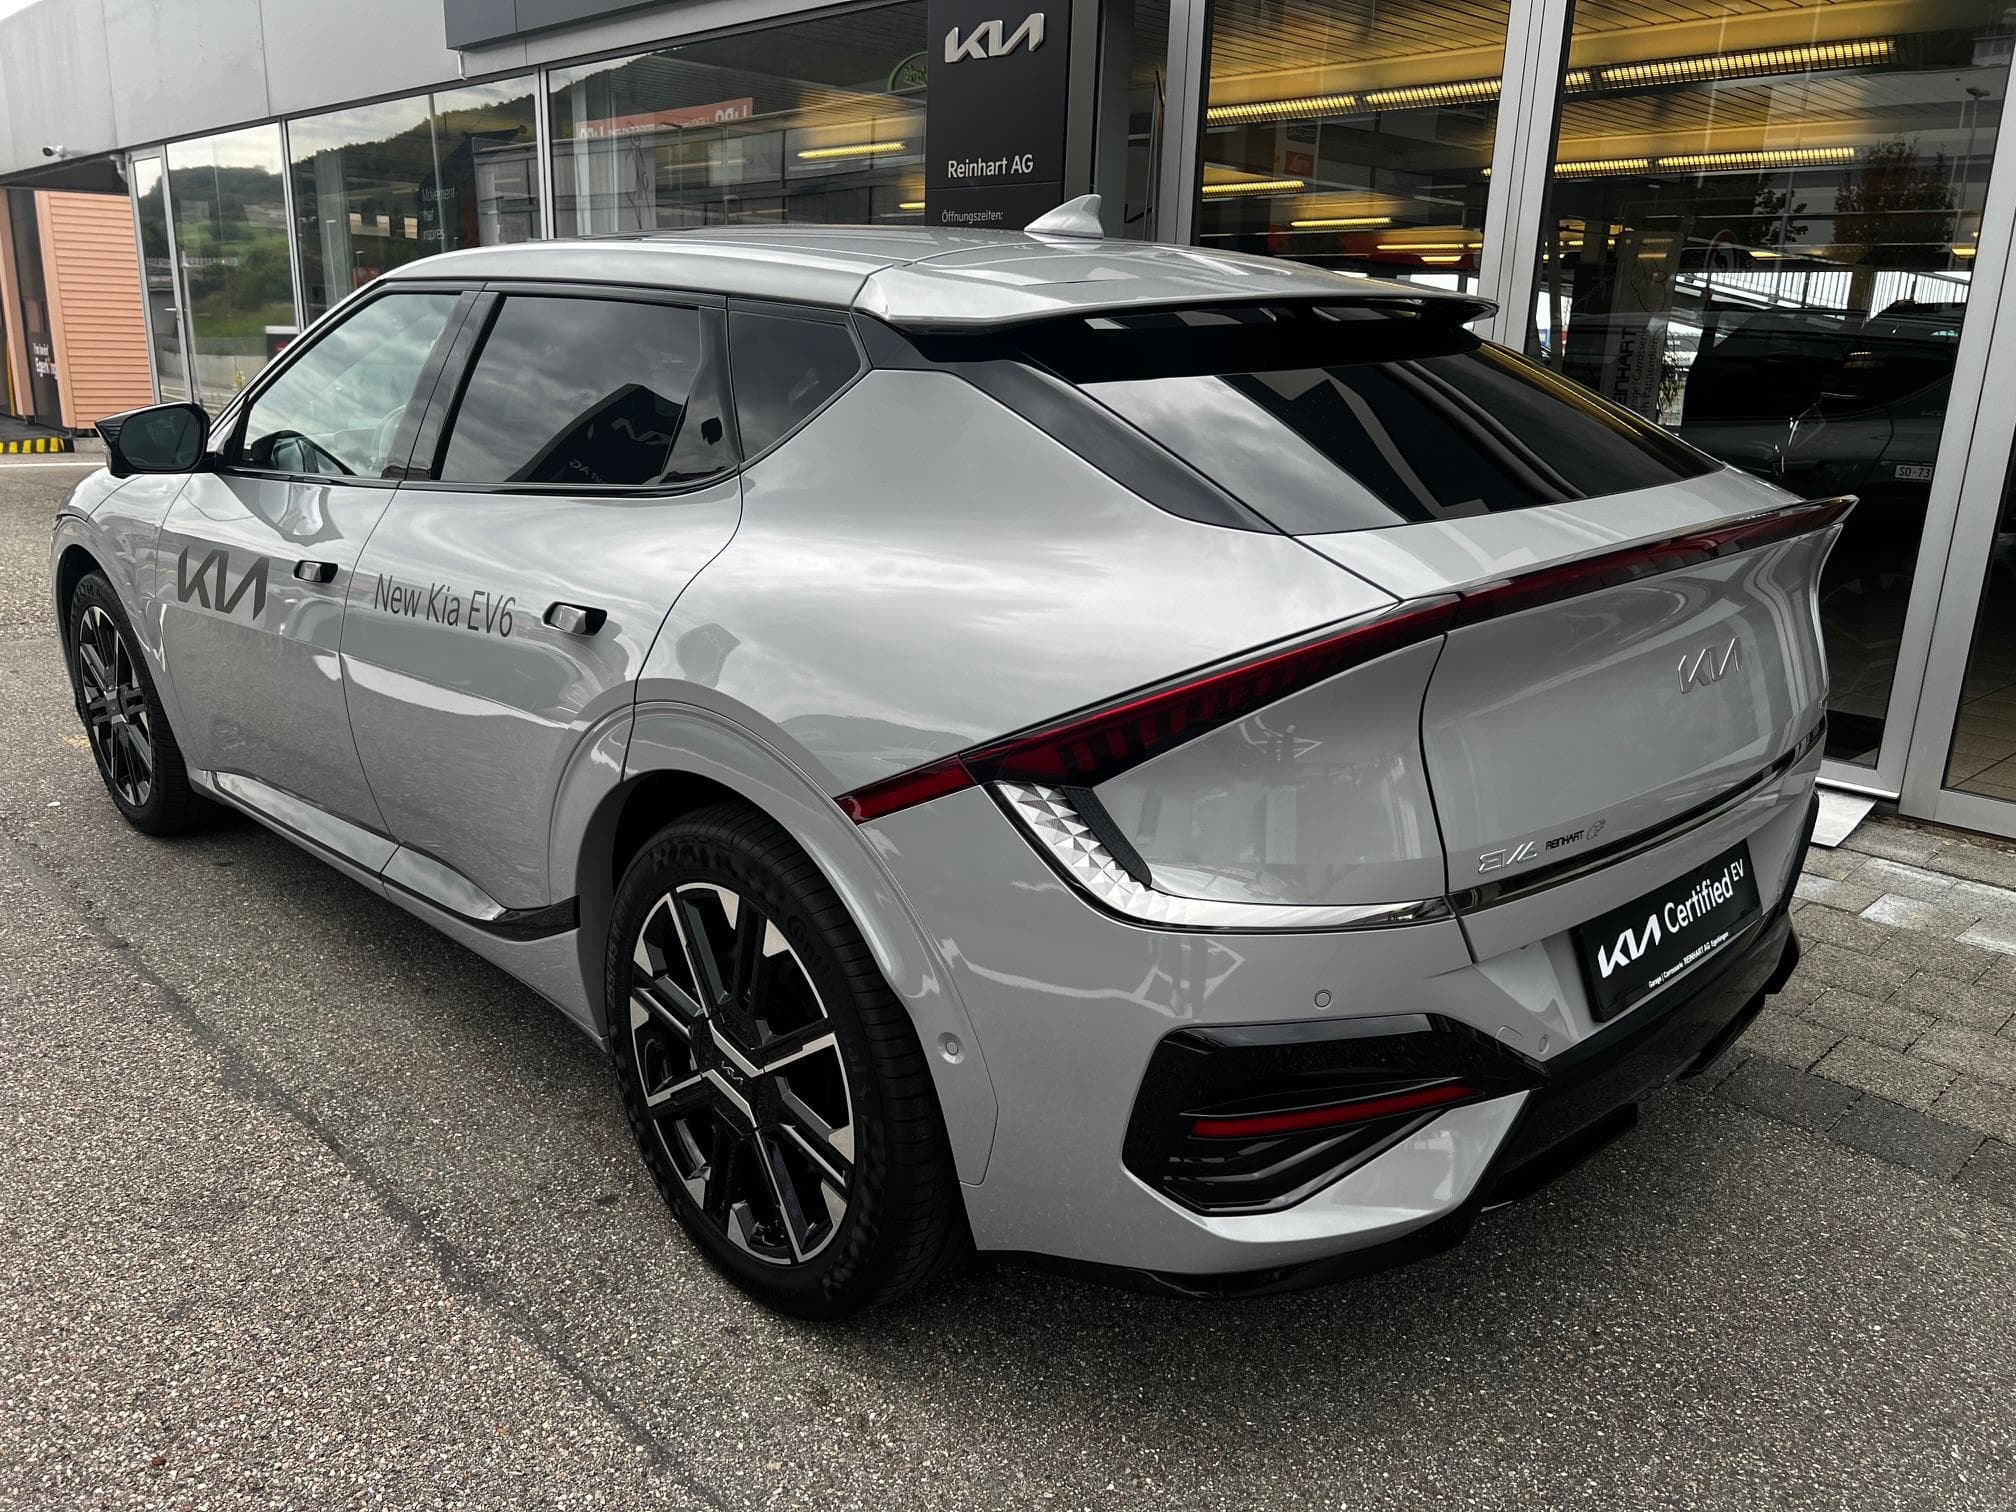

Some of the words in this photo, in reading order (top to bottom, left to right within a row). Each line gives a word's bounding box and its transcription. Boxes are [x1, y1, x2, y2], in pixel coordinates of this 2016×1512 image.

[944, 12, 1045, 63] KIA
[948, 157, 1008, 178] Reinhart
[1011, 154, 1034, 174] AG
[941, 209, 1004, 224] Öffnungszeiten:
[177, 545, 270, 622] KIA
[374, 572, 422, 618] New
[426, 582, 460, 627] Kia
[467, 590, 517, 638] EV6
[1678, 635, 1742, 694] KIA
[1598, 914, 1662, 979] KIA
[1664, 868, 1734, 934] Certified
[1730, 858, 1745, 882] EV
